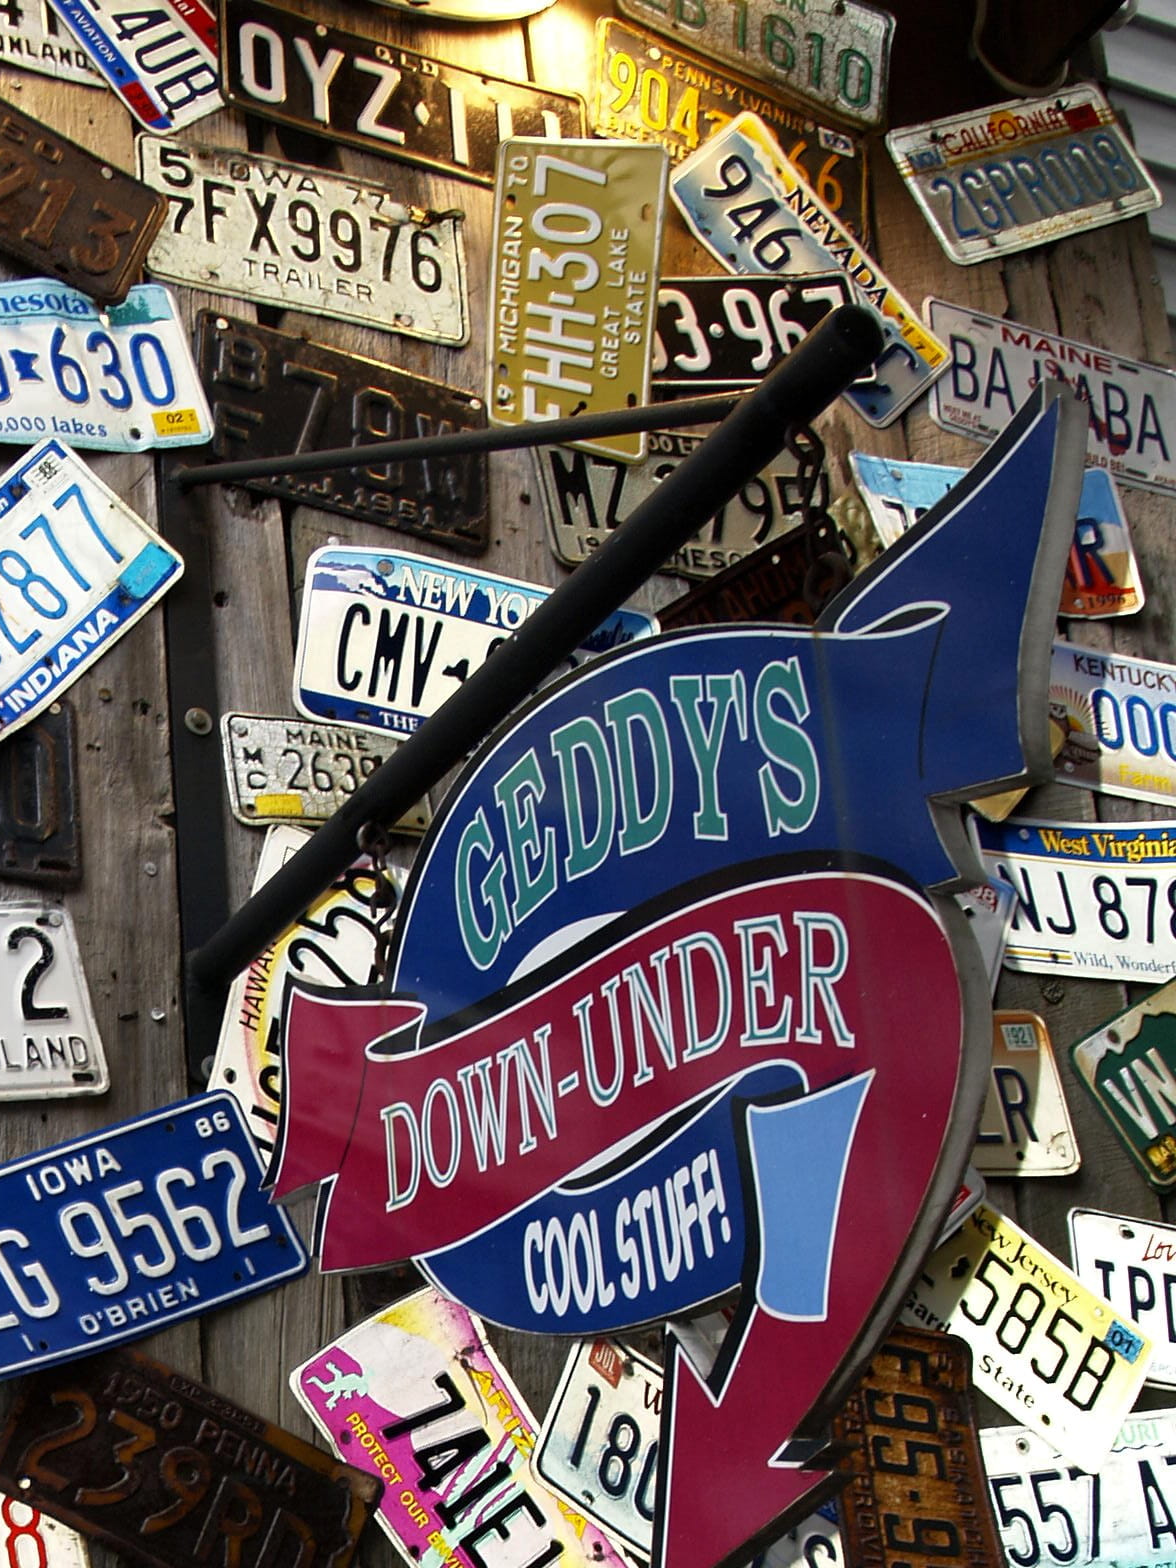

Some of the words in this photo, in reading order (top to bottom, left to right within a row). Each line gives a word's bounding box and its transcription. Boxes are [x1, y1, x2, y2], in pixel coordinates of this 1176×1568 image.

[701, 153, 806, 272] 946
[243, 257, 375, 303] TRAILER
[608, 227, 630, 288] LAKE
[782, 184, 890, 309] NEVADA
[498, 215, 525, 356] MICHIGAN
[623, 270, 648, 345] STATE
[49, 324, 177, 412] 630
[600, 306, 624, 380] GREAT
[1001, 326, 1114, 375] MAINE
[51, 415, 109, 440] lakes
[396, 564, 475, 618] NEW
[4, 607, 122, 713] INDIANA
[285, 728, 368, 752] MAINE
[453, 656, 821, 972] GEDDY'S
[1037, 829, 1091, 857] West
[1073, 951, 1115, 971] Wild,
[380, 910, 856, 1213] DOWN-UNDER
[194, 1111, 232, 1139] 86
[25, 1146, 122, 1203] IOWA
[58, 1148, 271, 1297] 9562
[523, 1208, 616, 1317] COOL
[616, 1147, 733, 1301] STUFF!
[78, 1276, 201, 1337] O'BRIEN
[978, 1353, 1037, 1410] State
[344, 1411, 402, 1487] PROTECT
